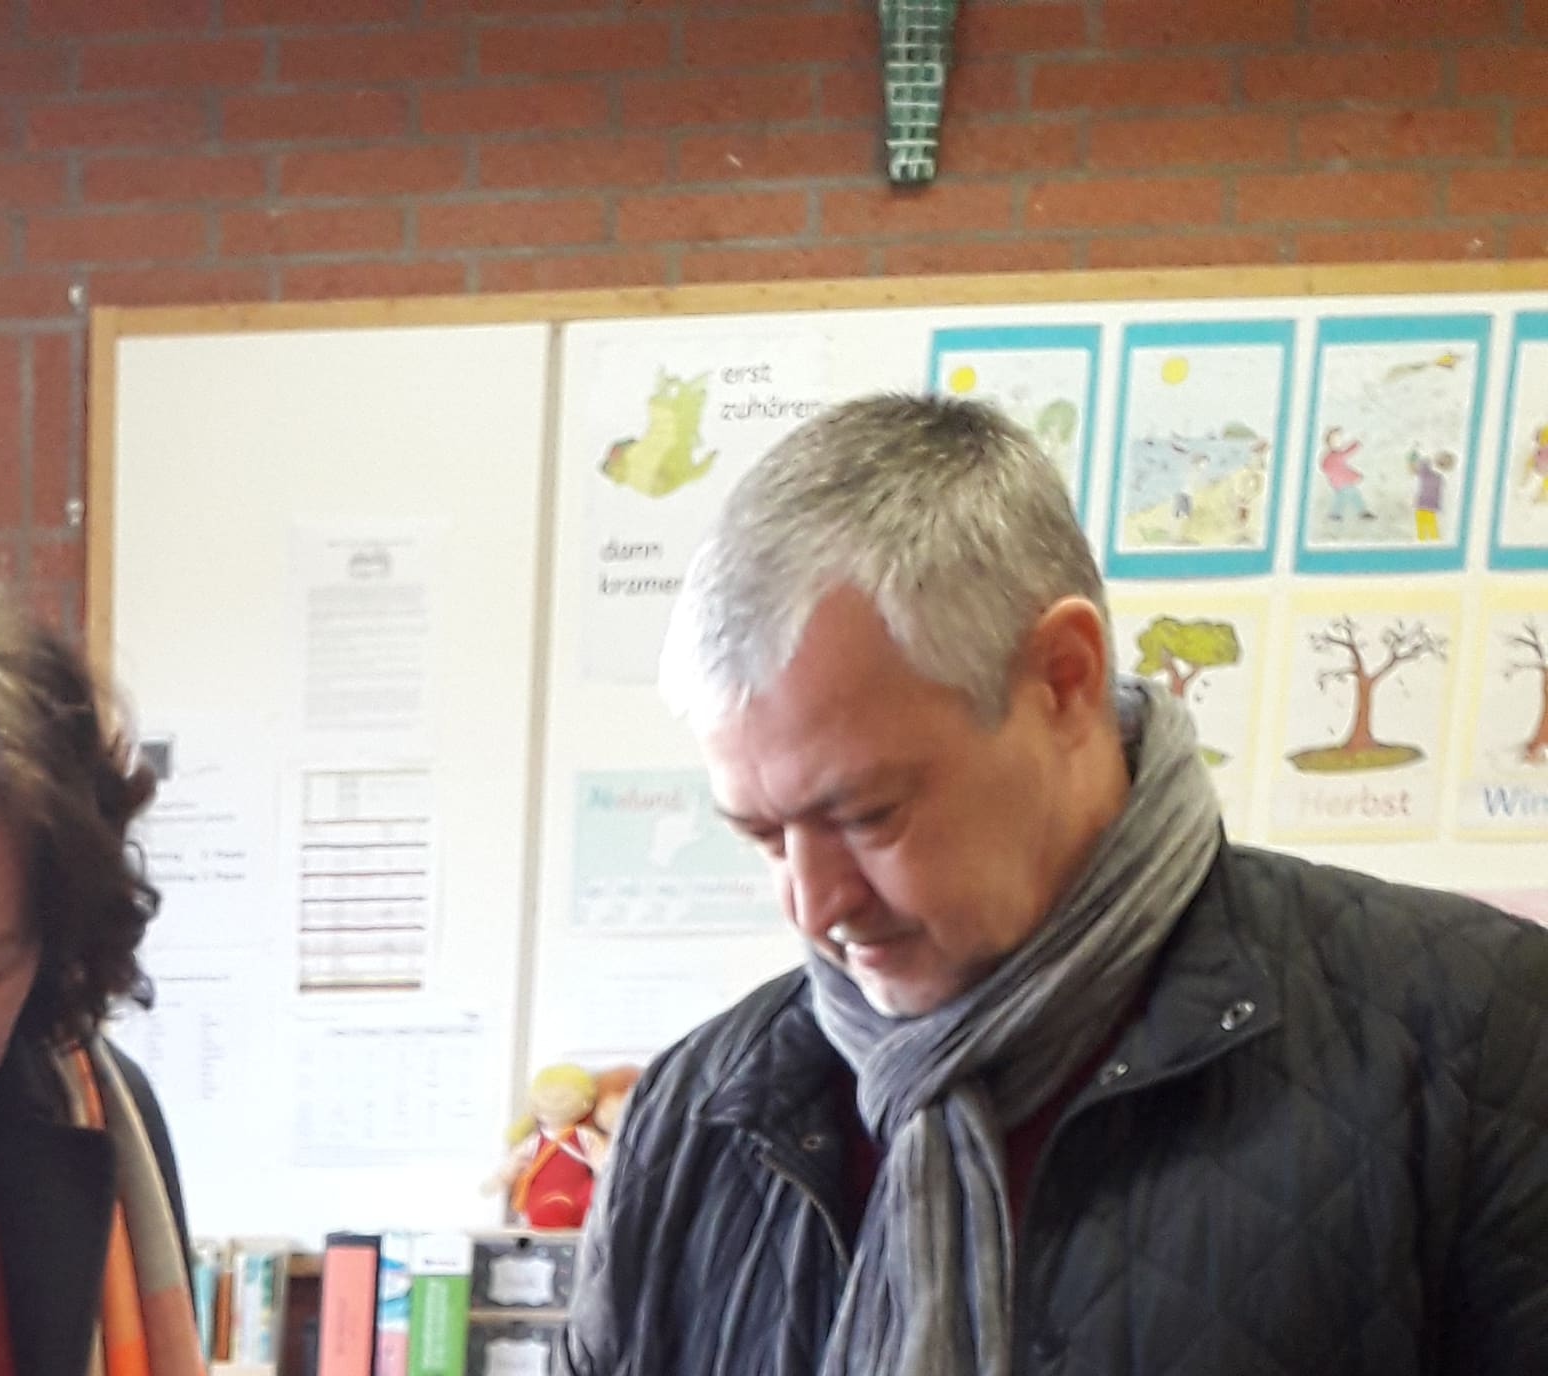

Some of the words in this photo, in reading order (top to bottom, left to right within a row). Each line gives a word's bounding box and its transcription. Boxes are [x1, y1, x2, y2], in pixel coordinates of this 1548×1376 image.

[720, 361, 772, 385] erst
[599, 537, 662, 562] dann
[1299, 785, 1411, 817] Herbst
